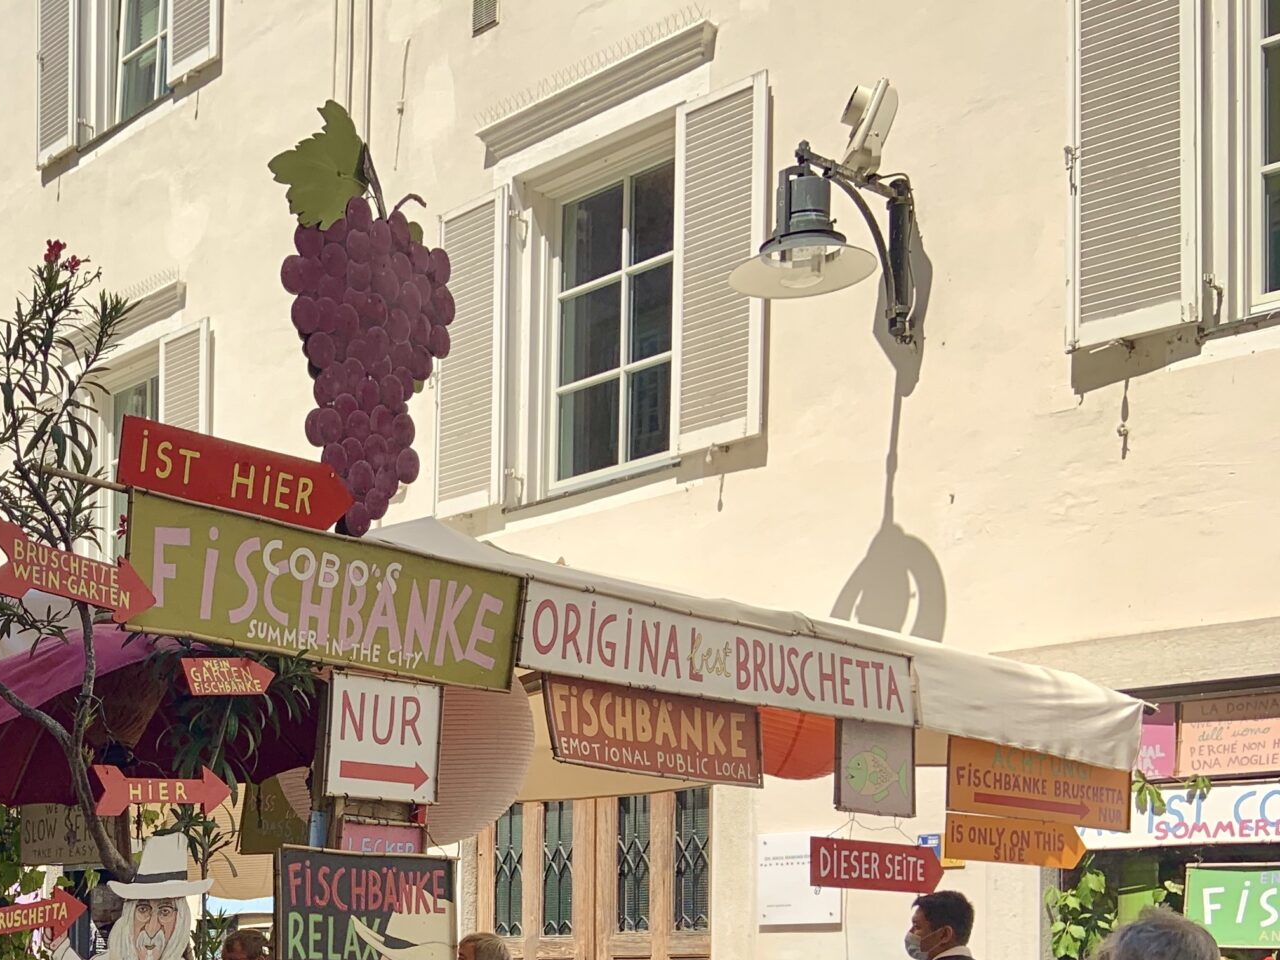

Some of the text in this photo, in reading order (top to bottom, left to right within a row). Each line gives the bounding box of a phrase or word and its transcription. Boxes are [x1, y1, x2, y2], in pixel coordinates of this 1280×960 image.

[13, 538, 119, 588] BRUSCHETTE
[246, 618, 318, 650] SUMMER
[350, 643, 381, 664] THE
[190, 666, 253, 682] GARTEN
[735, 636, 906, 714] BRUSCHETTA
[339, 690, 423, 746] NUR
[1242, 740, 1266, 751] NON
[715, 759, 755, 782] LOCAL
[1191, 758, 1222, 771] UNA
[1054, 780, 1124, 805] BRUSCHETTA
[1098, 808, 1123, 823] NUR
[24, 818, 57, 845] SLOW
[968, 826, 1006, 846] ONLY
[1010, 830, 1031, 848] ON
[68, 845, 95, 858] EASY
